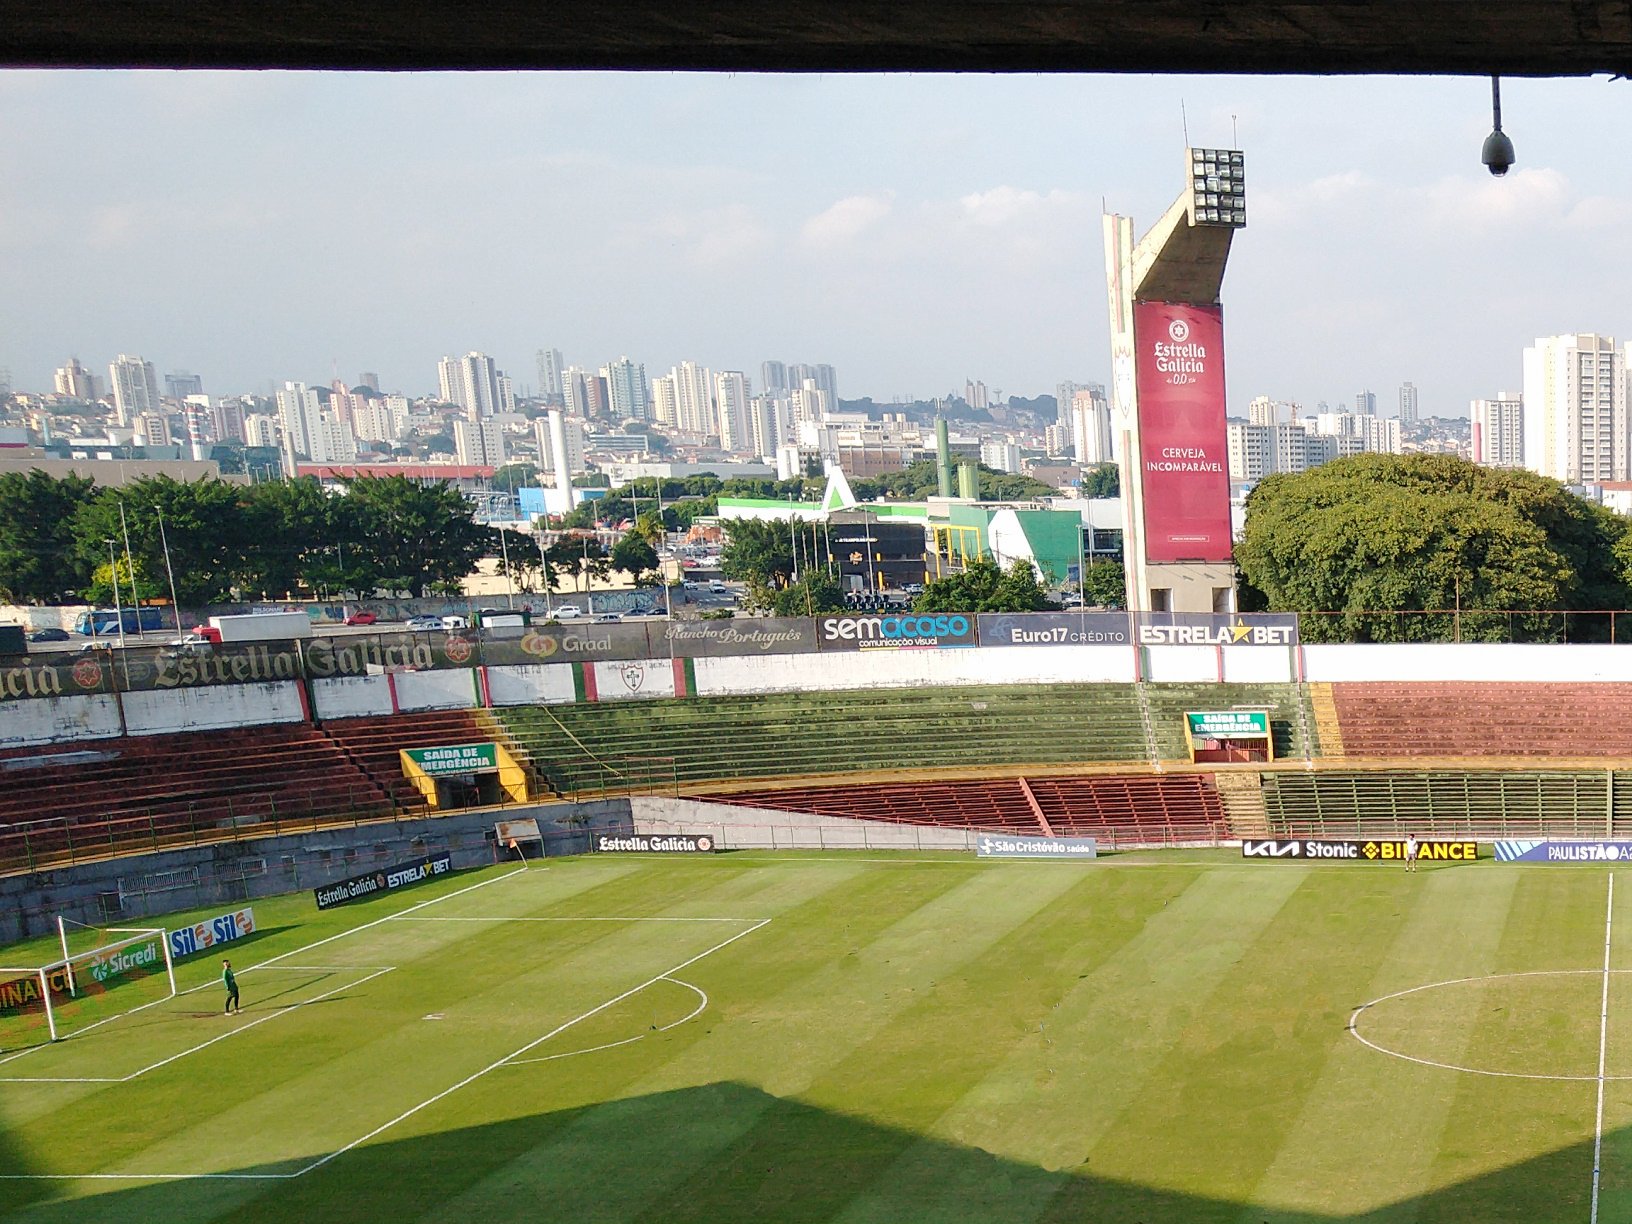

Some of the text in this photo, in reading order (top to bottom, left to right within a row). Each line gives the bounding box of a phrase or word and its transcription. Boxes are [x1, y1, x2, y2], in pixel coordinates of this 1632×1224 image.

[1154, 342, 1206, 358] Estrella
[1156, 357, 1204, 373] Galicia
[1162, 448, 1206, 459] CERVEJA
[1147, 461, 1222, 472] INCOMPARÁVEL
[562, 634, 612, 651] Graal
[664, 624, 801, 650] Rancho Português
[859, 636, 938, 648] comunicação visual
[1011, 628, 1124, 643] Euro17 CRÉDITO
[1140, 626, 1293, 644] ESTRELA BET
[154, 645, 297, 687] Estrella
[305, 634, 434, 676] Galicia
[424, 748, 478, 760] SAÍDA DE
[418, 757, 490, 771] MERGÊNCIA
[600, 836, 696, 851] Estrella Galicia
[995, 841, 1089, 853] São Cristóvão saúde
[1306, 841, 1358, 858] Stonic
[387, 858, 450, 888] ESTRELA BET
[317, 876, 378, 906] Estrella Galicia
[213, 915, 237, 942] Sil
[171, 927, 197, 957] Sil
[110, 943, 156, 973] Sicredi
